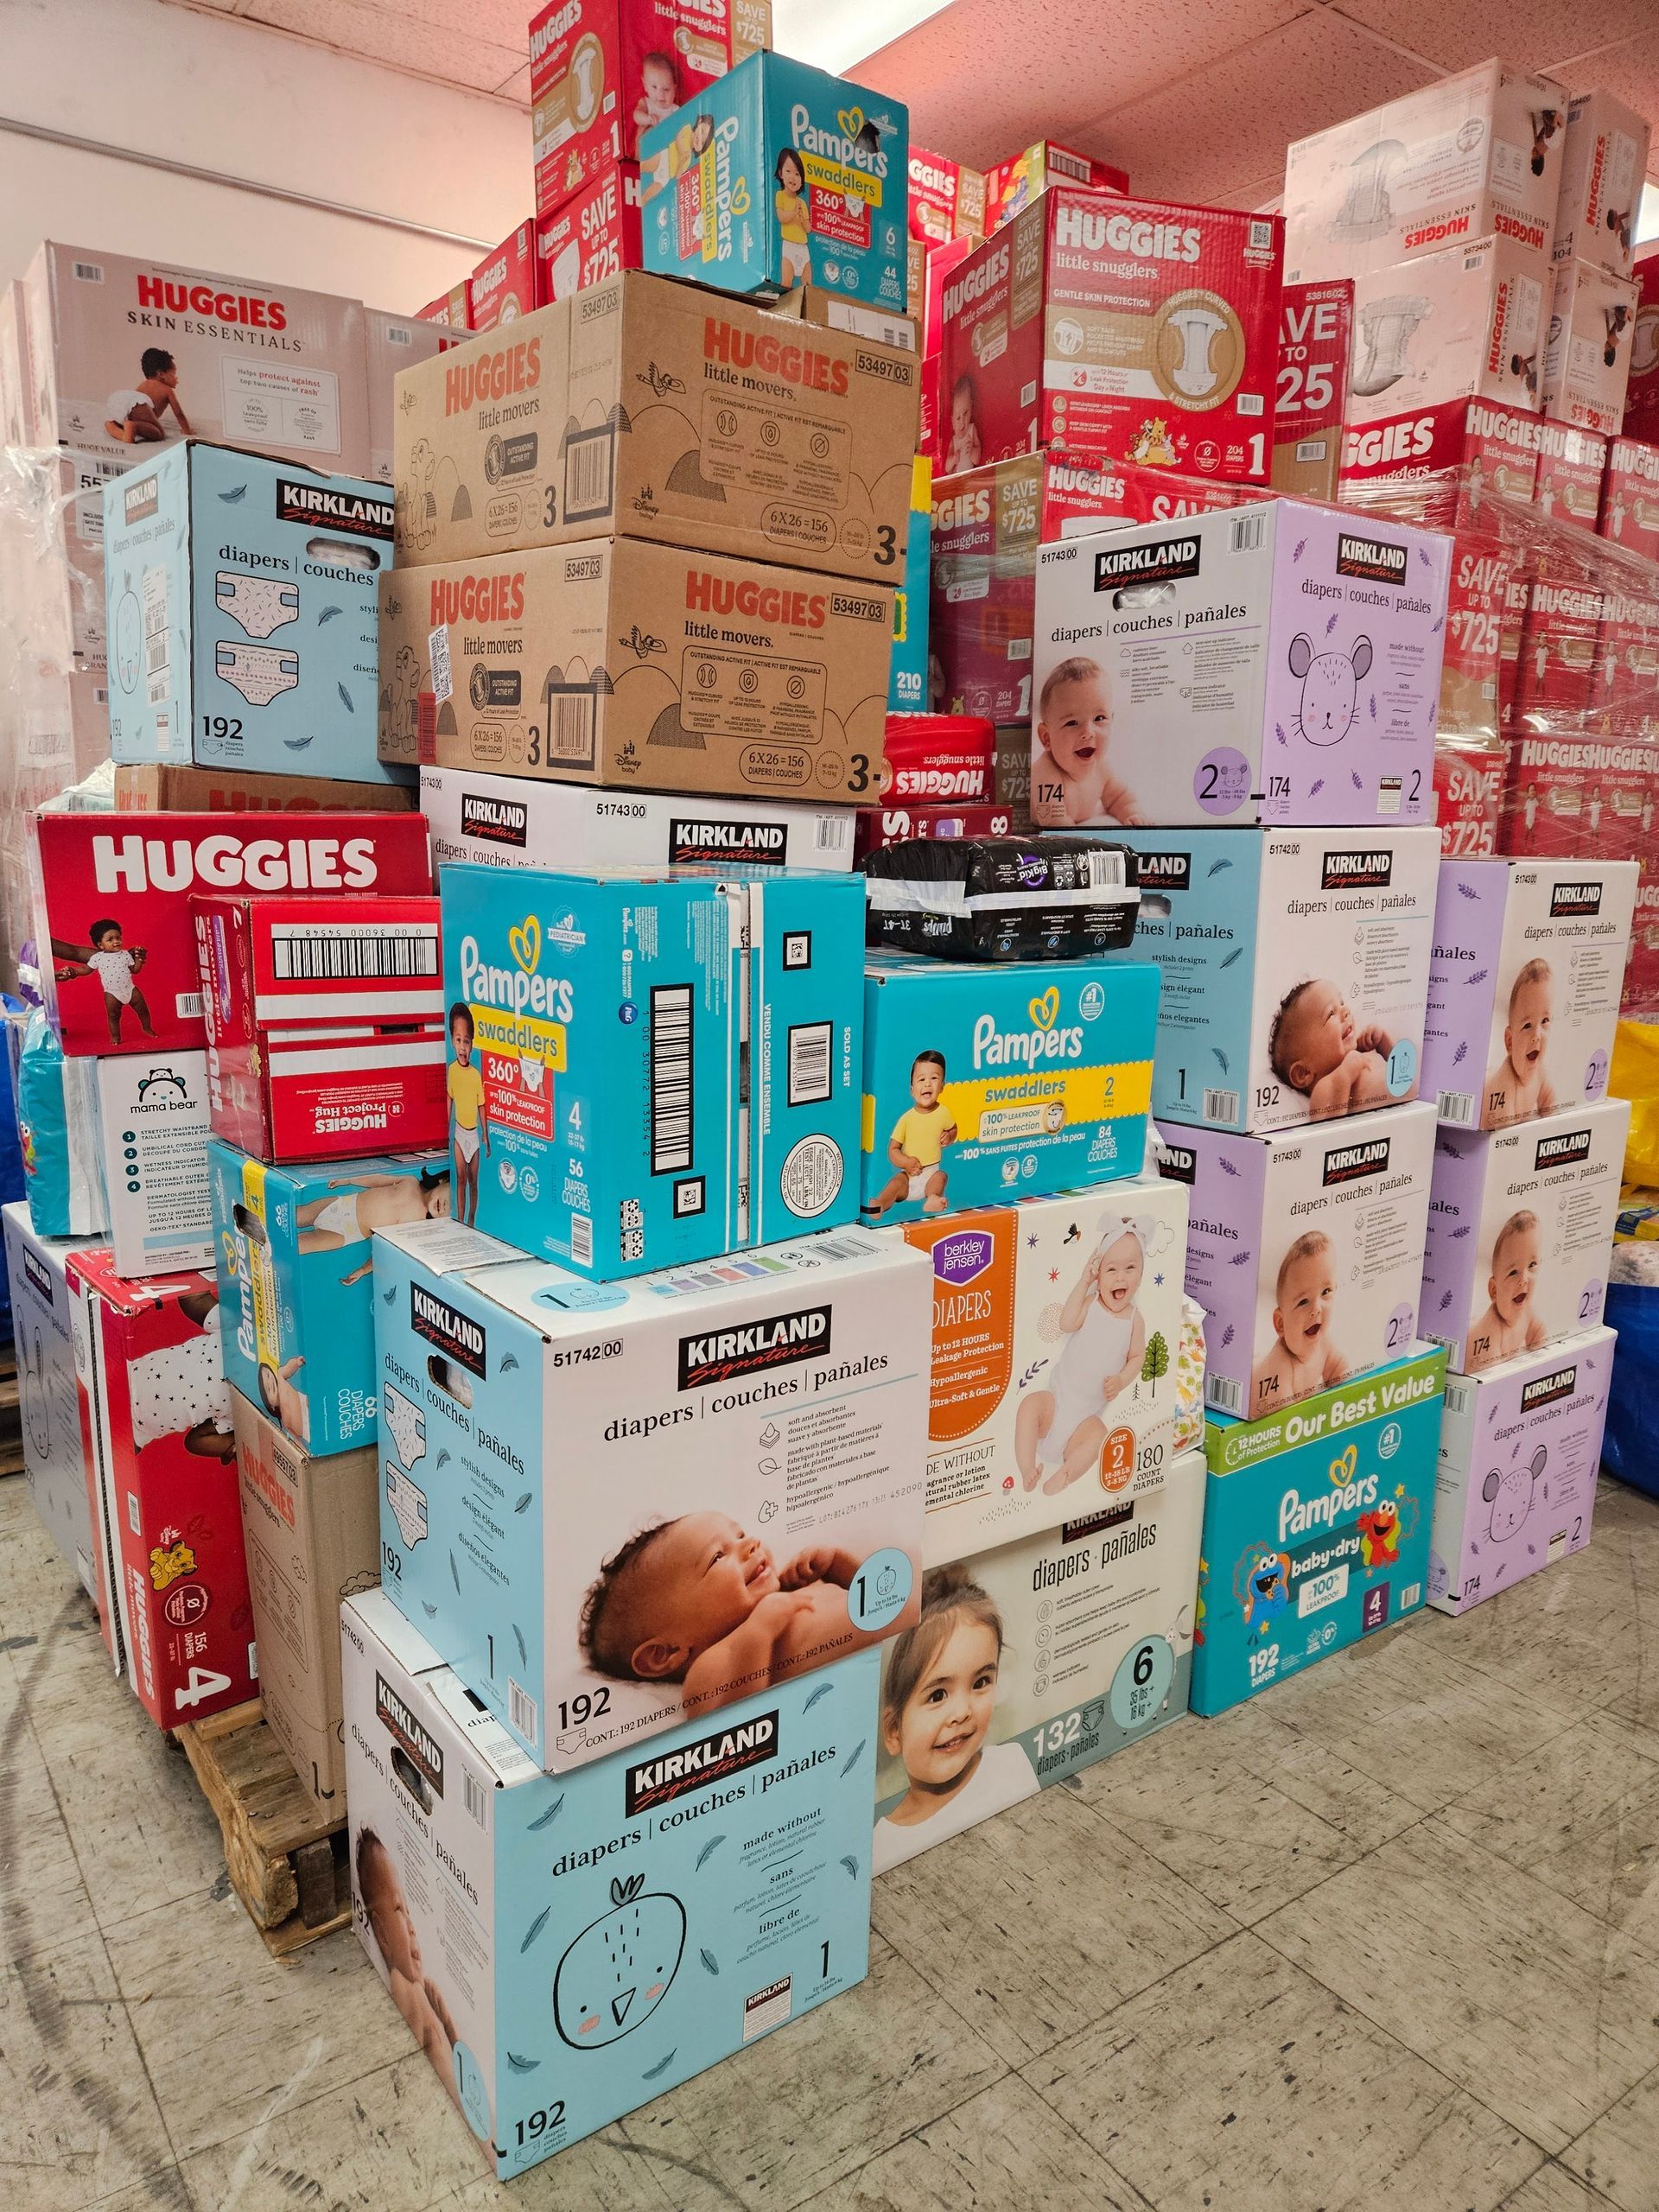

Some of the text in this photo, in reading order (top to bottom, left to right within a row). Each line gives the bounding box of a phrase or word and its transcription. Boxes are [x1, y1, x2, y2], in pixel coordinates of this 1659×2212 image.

[735, 3, 766, 21] SAVE
[581, 185, 617, 240] SAVE
[1055, 207, 1202, 263] HUGGIES
[1404, 216, 1469, 249] HUGGIES
[885, 266, 896, 278] 44
[137, 274, 287, 331] HUGGIES
[1054, 289, 1150, 308] GENTLE SKIN PROTECTION
[127, 311, 303, 353] SKIN ESSENTIALS
[703, 316, 849, 394] HUGGIES
[238, 368, 321, 387] Helps protect against
[445, 336, 541, 417] HUGGIES
[703, 363, 797, 402] little movers.
[1227, 445, 1243, 455] 204
[219, 544, 375, 587] diapers couches
[1100, 541, 1197, 575] KIRKLAND
[430, 571, 525, 627] HUGGIES
[686, 570, 827, 629] HUGGIES
[1301, 579, 1432, 614] diapers couches pañales
[1468, 594, 1491, 609] UP TO
[684, 620, 774, 650] little movers.
[1051, 603, 1247, 644] diapers couches pañales
[896, 671, 921, 690] 210
[202, 715, 243, 740] 192
[528, 726, 540, 766] 3
[748, 767, 802, 778] DIAPERS COUCHES
[897, 770, 984, 796] HUGGIES
[1036, 783, 1065, 803] 174
[1269, 776, 1291, 798] 174
[676, 823, 783, 849] KIRKLAND
[92, 834, 378, 893] HUGGIES
[676, 845, 782, 862] Signature
[1325, 854, 1391, 874] KIRKLAND
[1287, 893, 1416, 918] diapers couches pañales
[1554, 886, 1600, 904] KIRKLAND
[1175, 922, 1234, 941] pañales
[1524, 921, 1617, 939] diapers couches pañales
[1152, 954, 1207, 965] stylish designs
[460, 935, 574, 1024] Pampers
[478, 1019, 558, 1058] swaddlers
[973, 1014, 1084, 1070] Pampers
[844, 1055, 850, 1069] AS
[985, 1080, 1066, 1103] swaddlers
[1104, 1077, 1115, 1096] 2
[1255, 1085, 1280, 1109] 192
[130, 1101, 198, 1114] mama bear
[315, 1103, 386, 1118] Project Hug
[1489, 1092, 1506, 1111] 174
[315, 1114, 387, 1134] HUGGIES
[490, 1103, 545, 1131] skin protection
[569, 1102, 582, 1131] 4
[982, 1122, 1040, 1136] skin protection
[1098, 1125, 1112, 1139] 84
[1538, 1134, 1590, 1159] KIRKLAND
[569, 1158, 583, 1177] 56
[147, 1191, 195, 1200] DERMATOLOGIST
[564, 1177, 588, 1198] DIAPERS
[1289, 1173, 1414, 1217] diapers couches pañales
[563, 1191, 590, 1211] COUCHES
[944, 1239, 985, 1260] berkley
[932, 1289, 992, 1330] DIAPERS
[412, 1288, 485, 1357] KIRKLAND
[687, 1313, 826, 1366] KIRKLAND
[931, 1343, 941, 1354] Up
[962, 1333, 990, 1346] HOURS
[1472, 1336, 1491, 1357] 174
[931, 1341, 1004, 1365] Leakage Protection
[931, 1367, 988, 1388] Hypoallergenic
[1258, 1375, 1280, 1399] 174
[365, 1395, 378, 1419] 66
[603, 1352, 889, 1442] diapers couches pañales
[930, 1391, 969, 1409] Ultra-Soft
[976, 1384, 1000, 1396] Gentle
[384, 1351, 524, 1476] diapers couches pañales
[788, 1414, 800, 1426] soft
[815, 1404, 846, 1419] absorbent
[1286, 1375, 1435, 1444] Our Best Value
[1494, 1391, 1595, 1441] diapers couches pañales
[788, 1424, 810, 1435] douces
[818, 1410, 855, 1426] absorbantes
[1110, 1434, 1128, 1445] SIZE
[944, 1446, 995, 1470] WITHOUT
[1113, 1445, 1124, 1468] 2
[1137, 1445, 1163, 1471] 180
[461, 1456, 505, 1497] stylish designs
[949, 1473, 990, 1491] rubber latex
[1133, 1476, 1164, 1491] DIAPERS
[1137, 1468, 1161, 1481] COUNT
[955, 1484, 984, 1497] chlorine
[461, 1496, 505, 1540] design élégant
[1279, 1473, 1378, 1543] Pampers
[1570, 1516, 1584, 1543] 2
[1033, 1522, 1157, 1593] diapers pañales
[1463, 1576, 1481, 1597] 174
[1370, 1591, 1381, 1611] 4
[194, 1631, 207, 1652] 156
[818, 1633, 854, 1653] PAÑALES
[1133, 1645, 1153, 1687] 6
[1252, 1668, 1276, 1687] DIAPERS
[557, 1686, 611, 1730] 192
[620, 1721, 635, 1734] 192
[636, 1704, 677, 1728] DIAPERS
[1033, 1713, 1081, 1758] 132
[634, 1719, 774, 1795] KIRKLAND
[551, 1742, 837, 1879] diapers couches pañales
[742, 1807, 822, 1851] made without
[769, 1867, 794, 1885] sans
[759, 1907, 800, 1935] libre de
[821, 1940, 830, 1979] 1
[747, 1978, 790, 2006] KIRKLAND
[516, 2100, 567, 2145] 192
